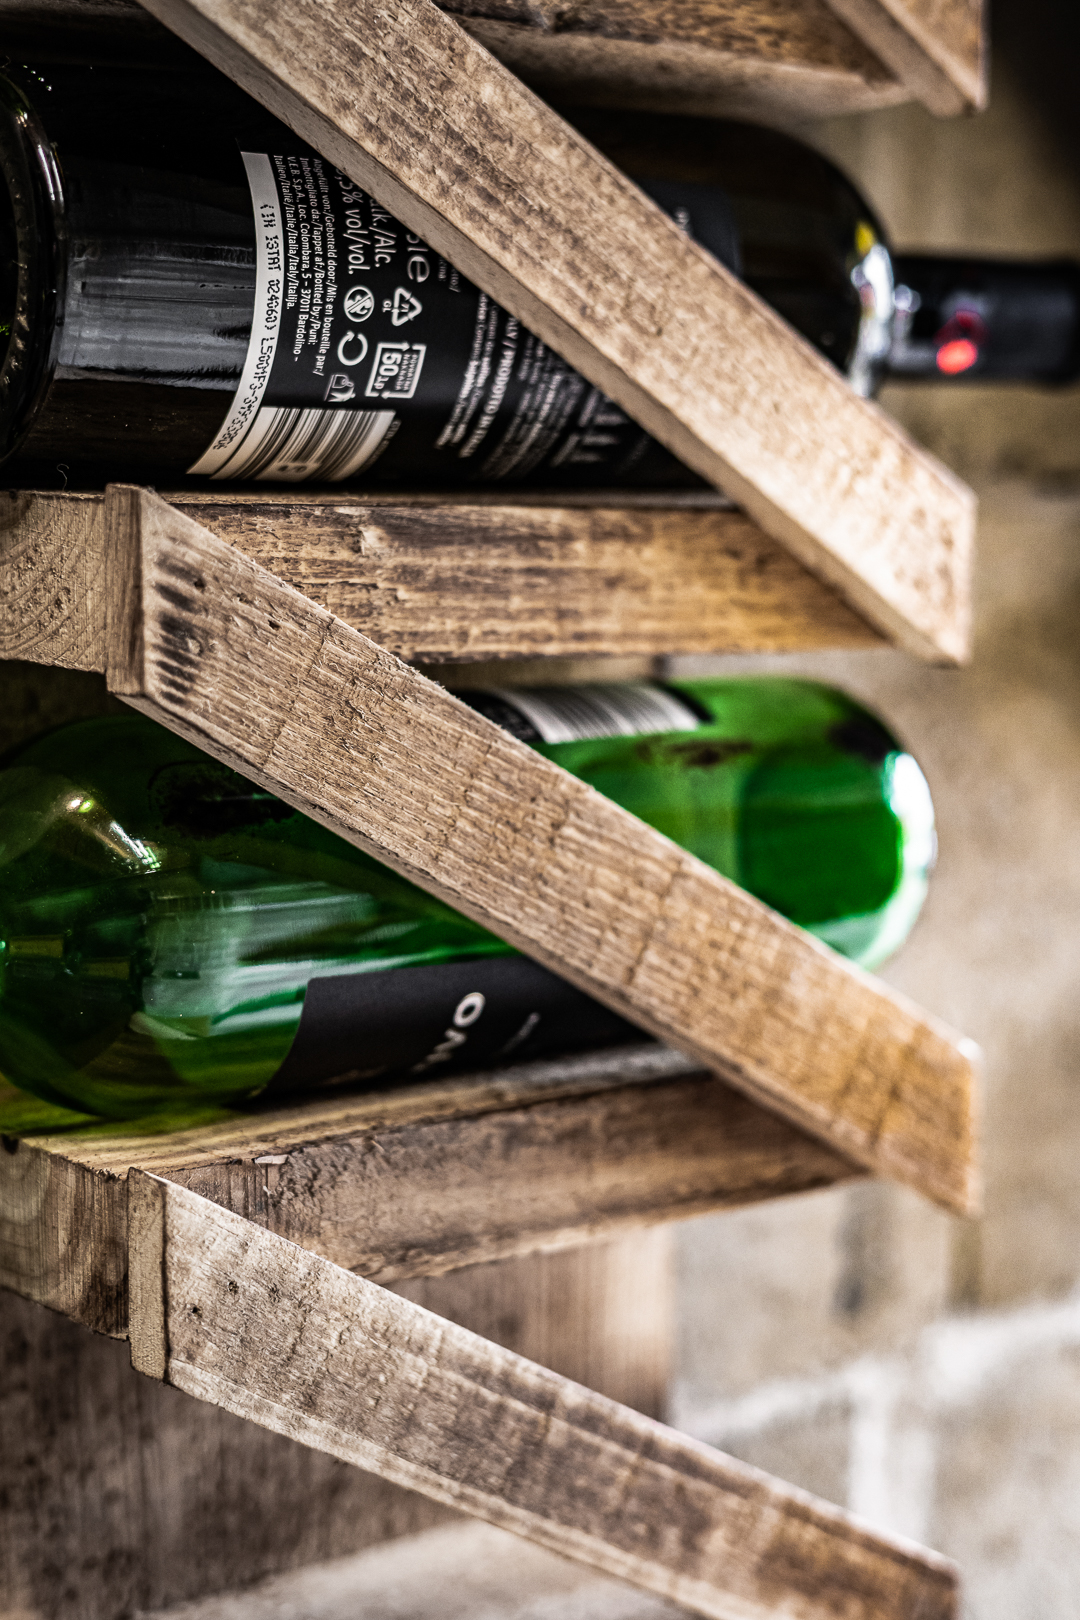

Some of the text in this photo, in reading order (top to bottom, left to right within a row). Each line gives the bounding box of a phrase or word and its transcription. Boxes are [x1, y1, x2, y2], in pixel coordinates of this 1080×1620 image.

[287, 156, 300, 176] V.E.B.
[313, 159, 329, 193] Abgefüllt
[298, 204, 307, 220] Loc.
[265, 235, 281, 271] ISTAT
[300, 223, 311, 271] Colombara,
[300, 158, 325, 345] Imbottigliato da:/Tappet af:/Bottled by:/Puni:
[343, 209, 371, 275] vol/vol.
[326, 260, 337, 302] door:/Mis
[300, 289, 311, 312] 37011
[326, 305, 334, 314] en
[382, 299, 392, 312] GL
[293, 314, 306, 355] Bardolino
[319, 318, 334, 353] bouteille
[312, 355, 326, 376] par:/
[395, 354, 410, 391] NAKNADA
[485, 350, 515, 414] PRODOTTO
[478, 415, 497, 429] IN
